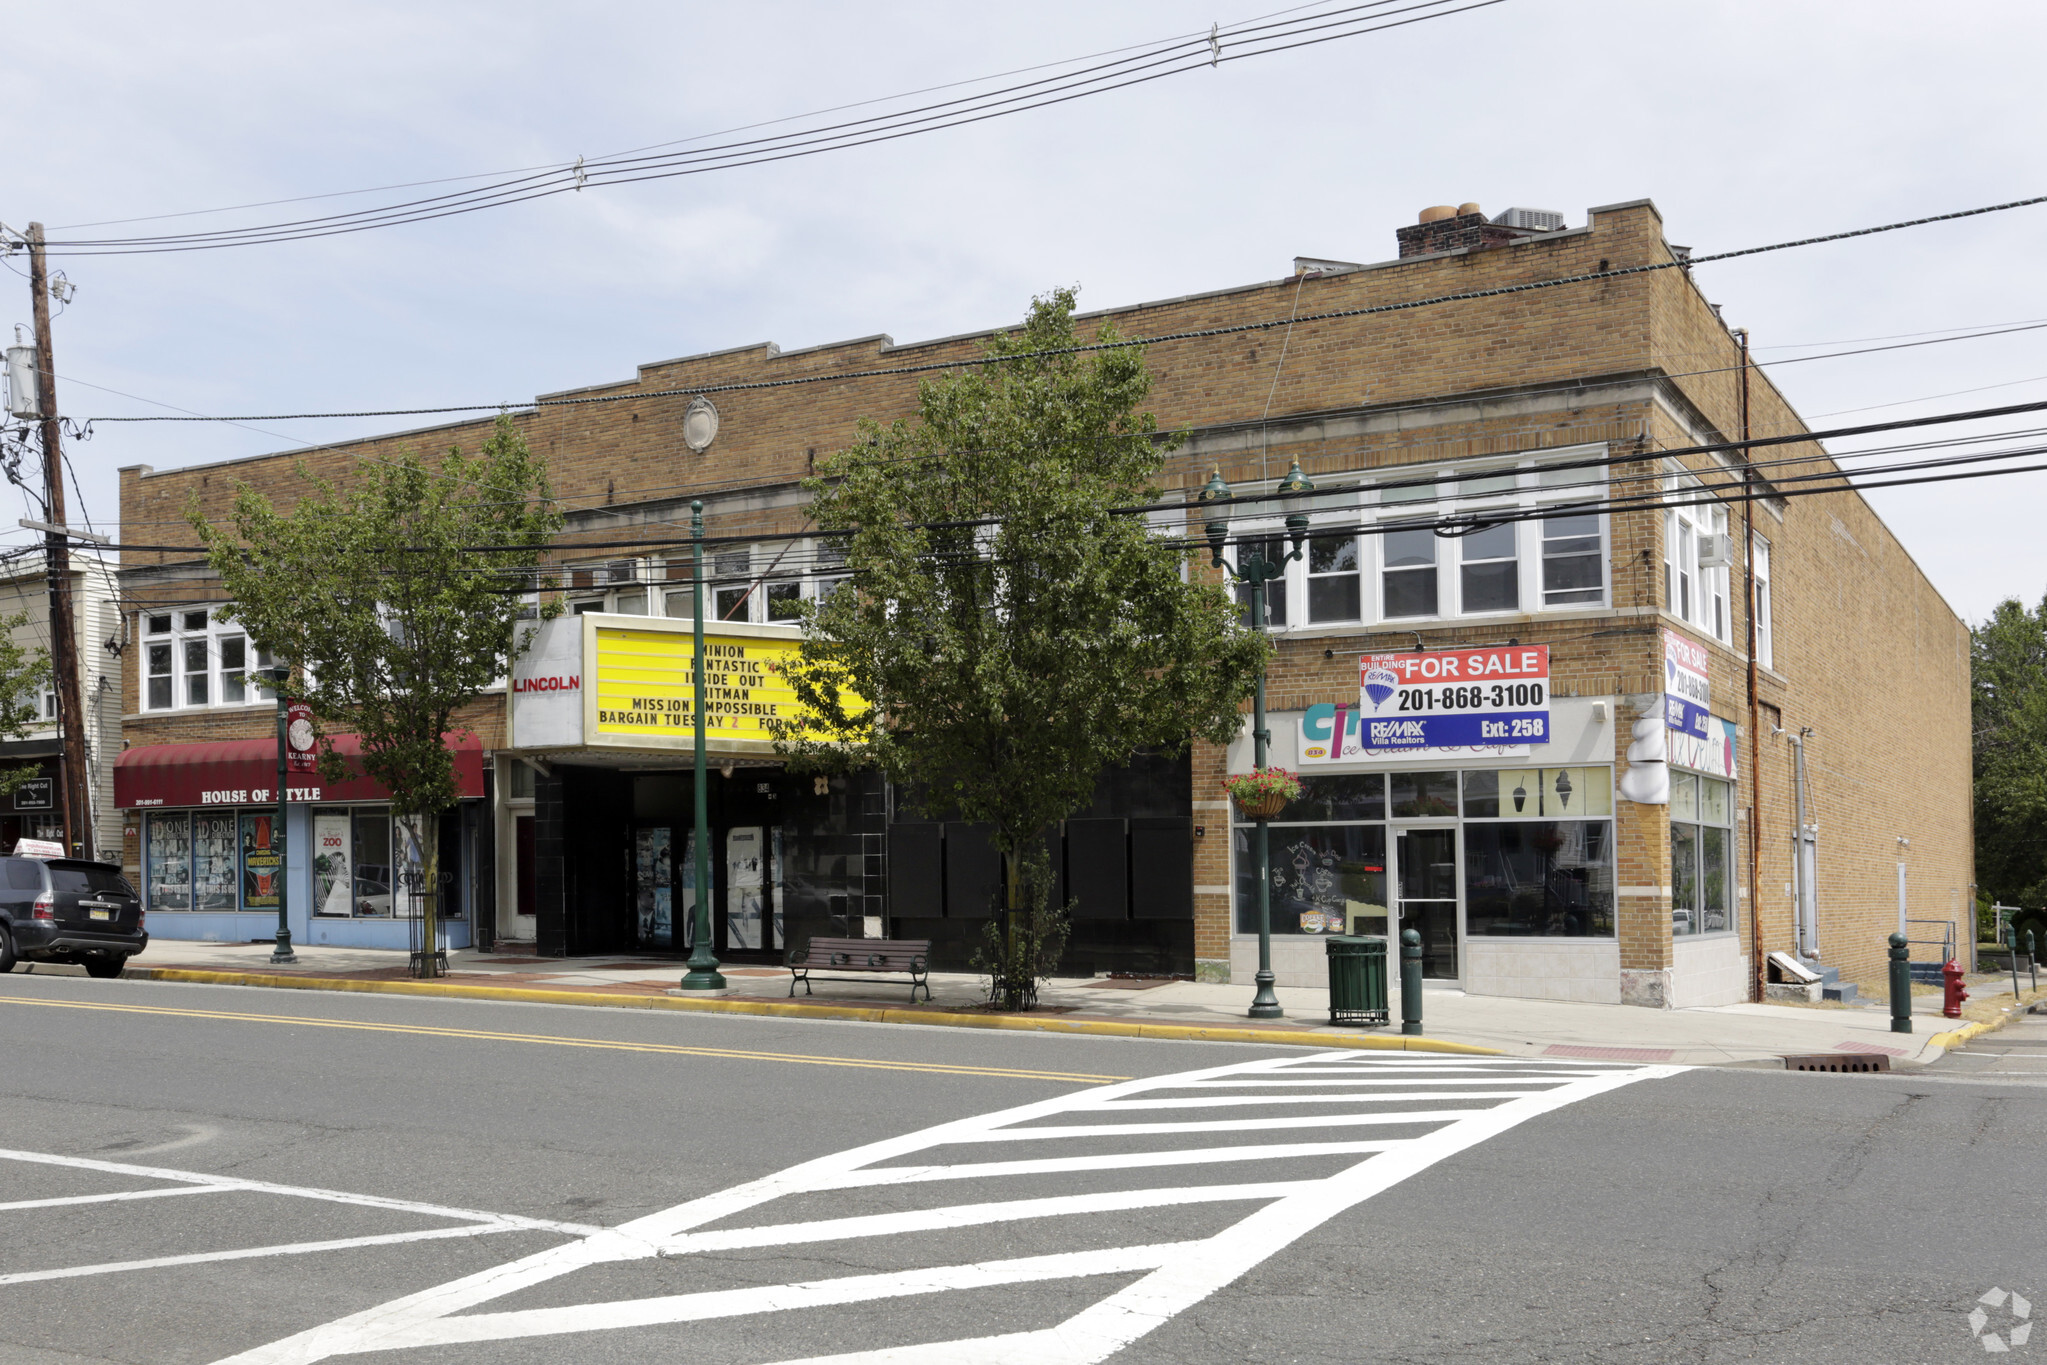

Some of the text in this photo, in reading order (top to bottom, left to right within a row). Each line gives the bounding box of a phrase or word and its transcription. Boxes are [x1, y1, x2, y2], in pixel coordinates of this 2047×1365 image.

[1676, 640, 1691, 665] FOR
[690, 658, 759, 673] FNTASTIC
[1361, 660, 1406, 670] BUILDING
[1405, 652, 1539, 678] FOR SALE
[514, 675, 580, 692] LINCOLN
[740, 674, 764, 687] OUT
[1368, 671, 1395, 683] RE/MAX
[1398, 684, 1543, 711] 201-868-3100
[632, 698, 777, 715] MISSION MPOSSIBLE
[600, 710, 782, 729] BARGAIN TUESAY 2 FOR
[1370, 718, 1544, 738] RE/MAX Ext: 258
[1371, 736, 1425, 745] Villa Realtors
[288, 752, 316, 761] KEARNY
[201, 788, 321, 804] HOUSE OF TYLE
[166, 821, 189, 833] ONE
[212, 820, 234, 832] ONE
[323, 838, 342, 846] ZOO
[248, 856, 279, 866] MAVERICKS
